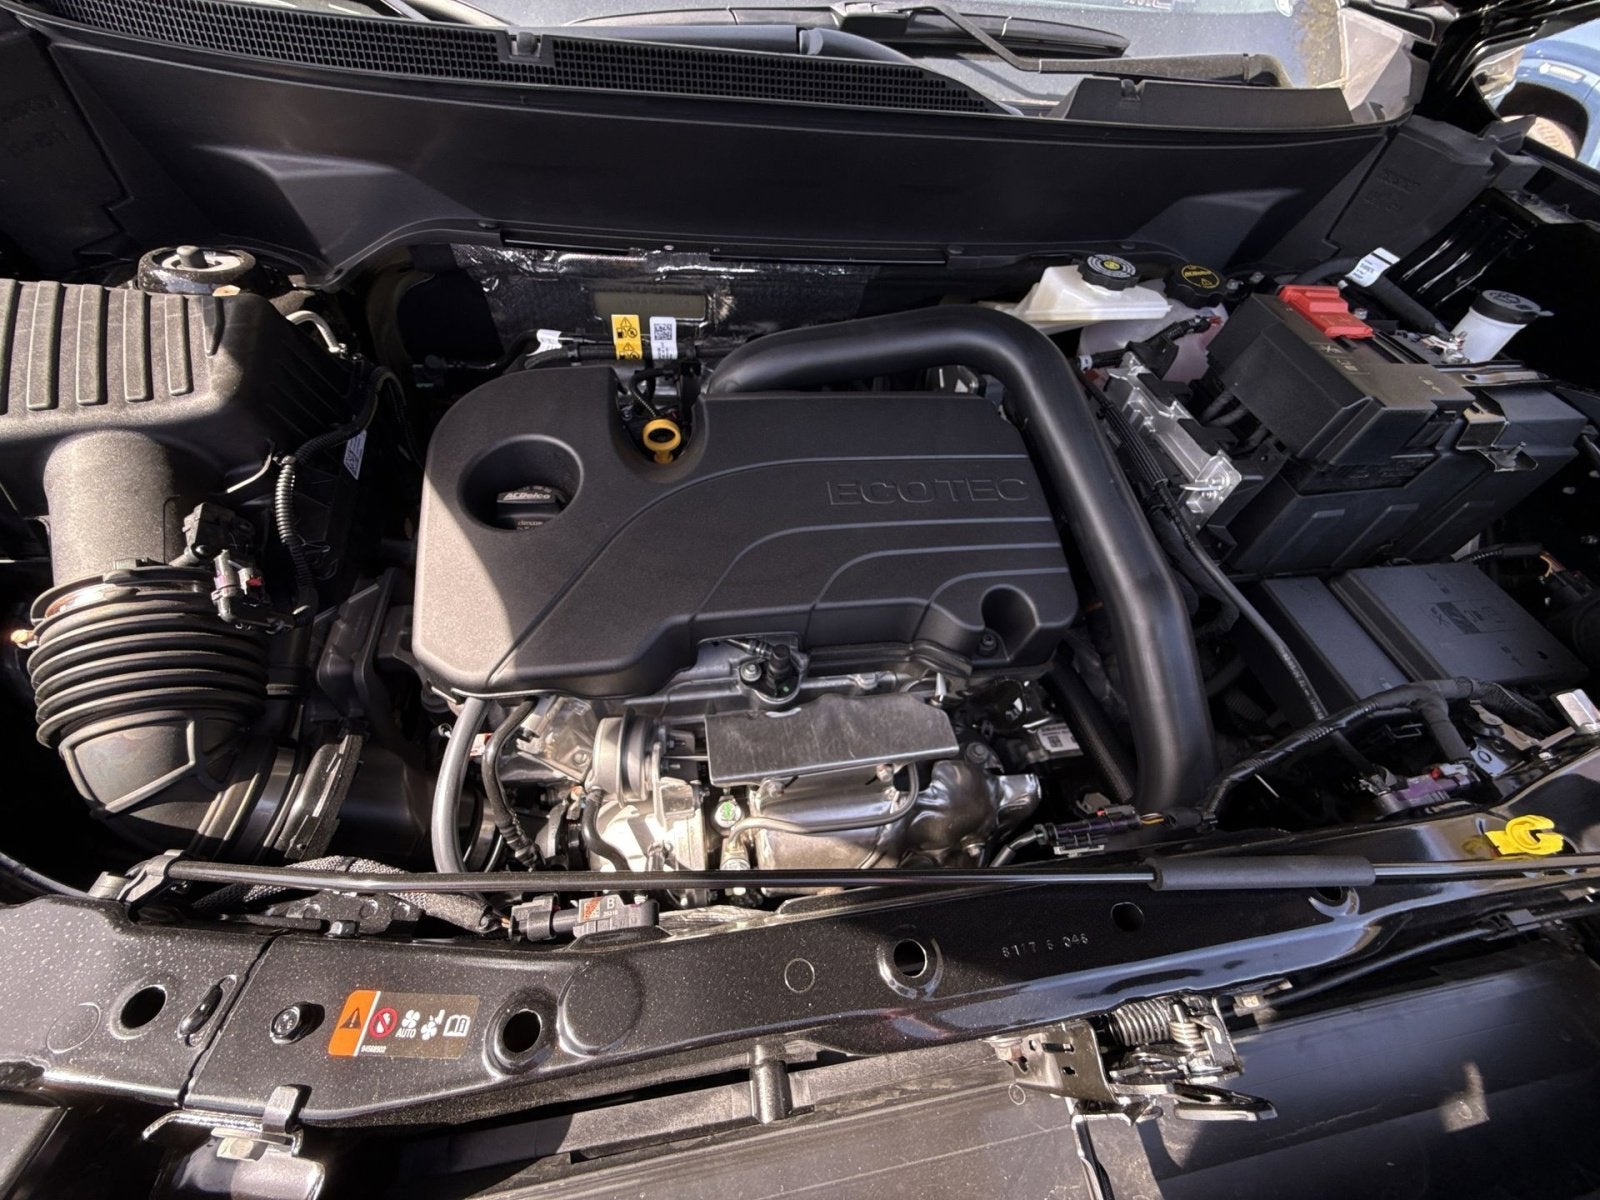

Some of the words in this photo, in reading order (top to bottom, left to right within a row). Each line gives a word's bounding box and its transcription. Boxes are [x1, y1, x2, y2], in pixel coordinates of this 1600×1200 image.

[503, 492, 551, 501] ACDelco
[826, 477, 1029, 505] ECOTEC
[606, 898, 615, 909] B
[395, 1027, 417, 1038] AUTO
